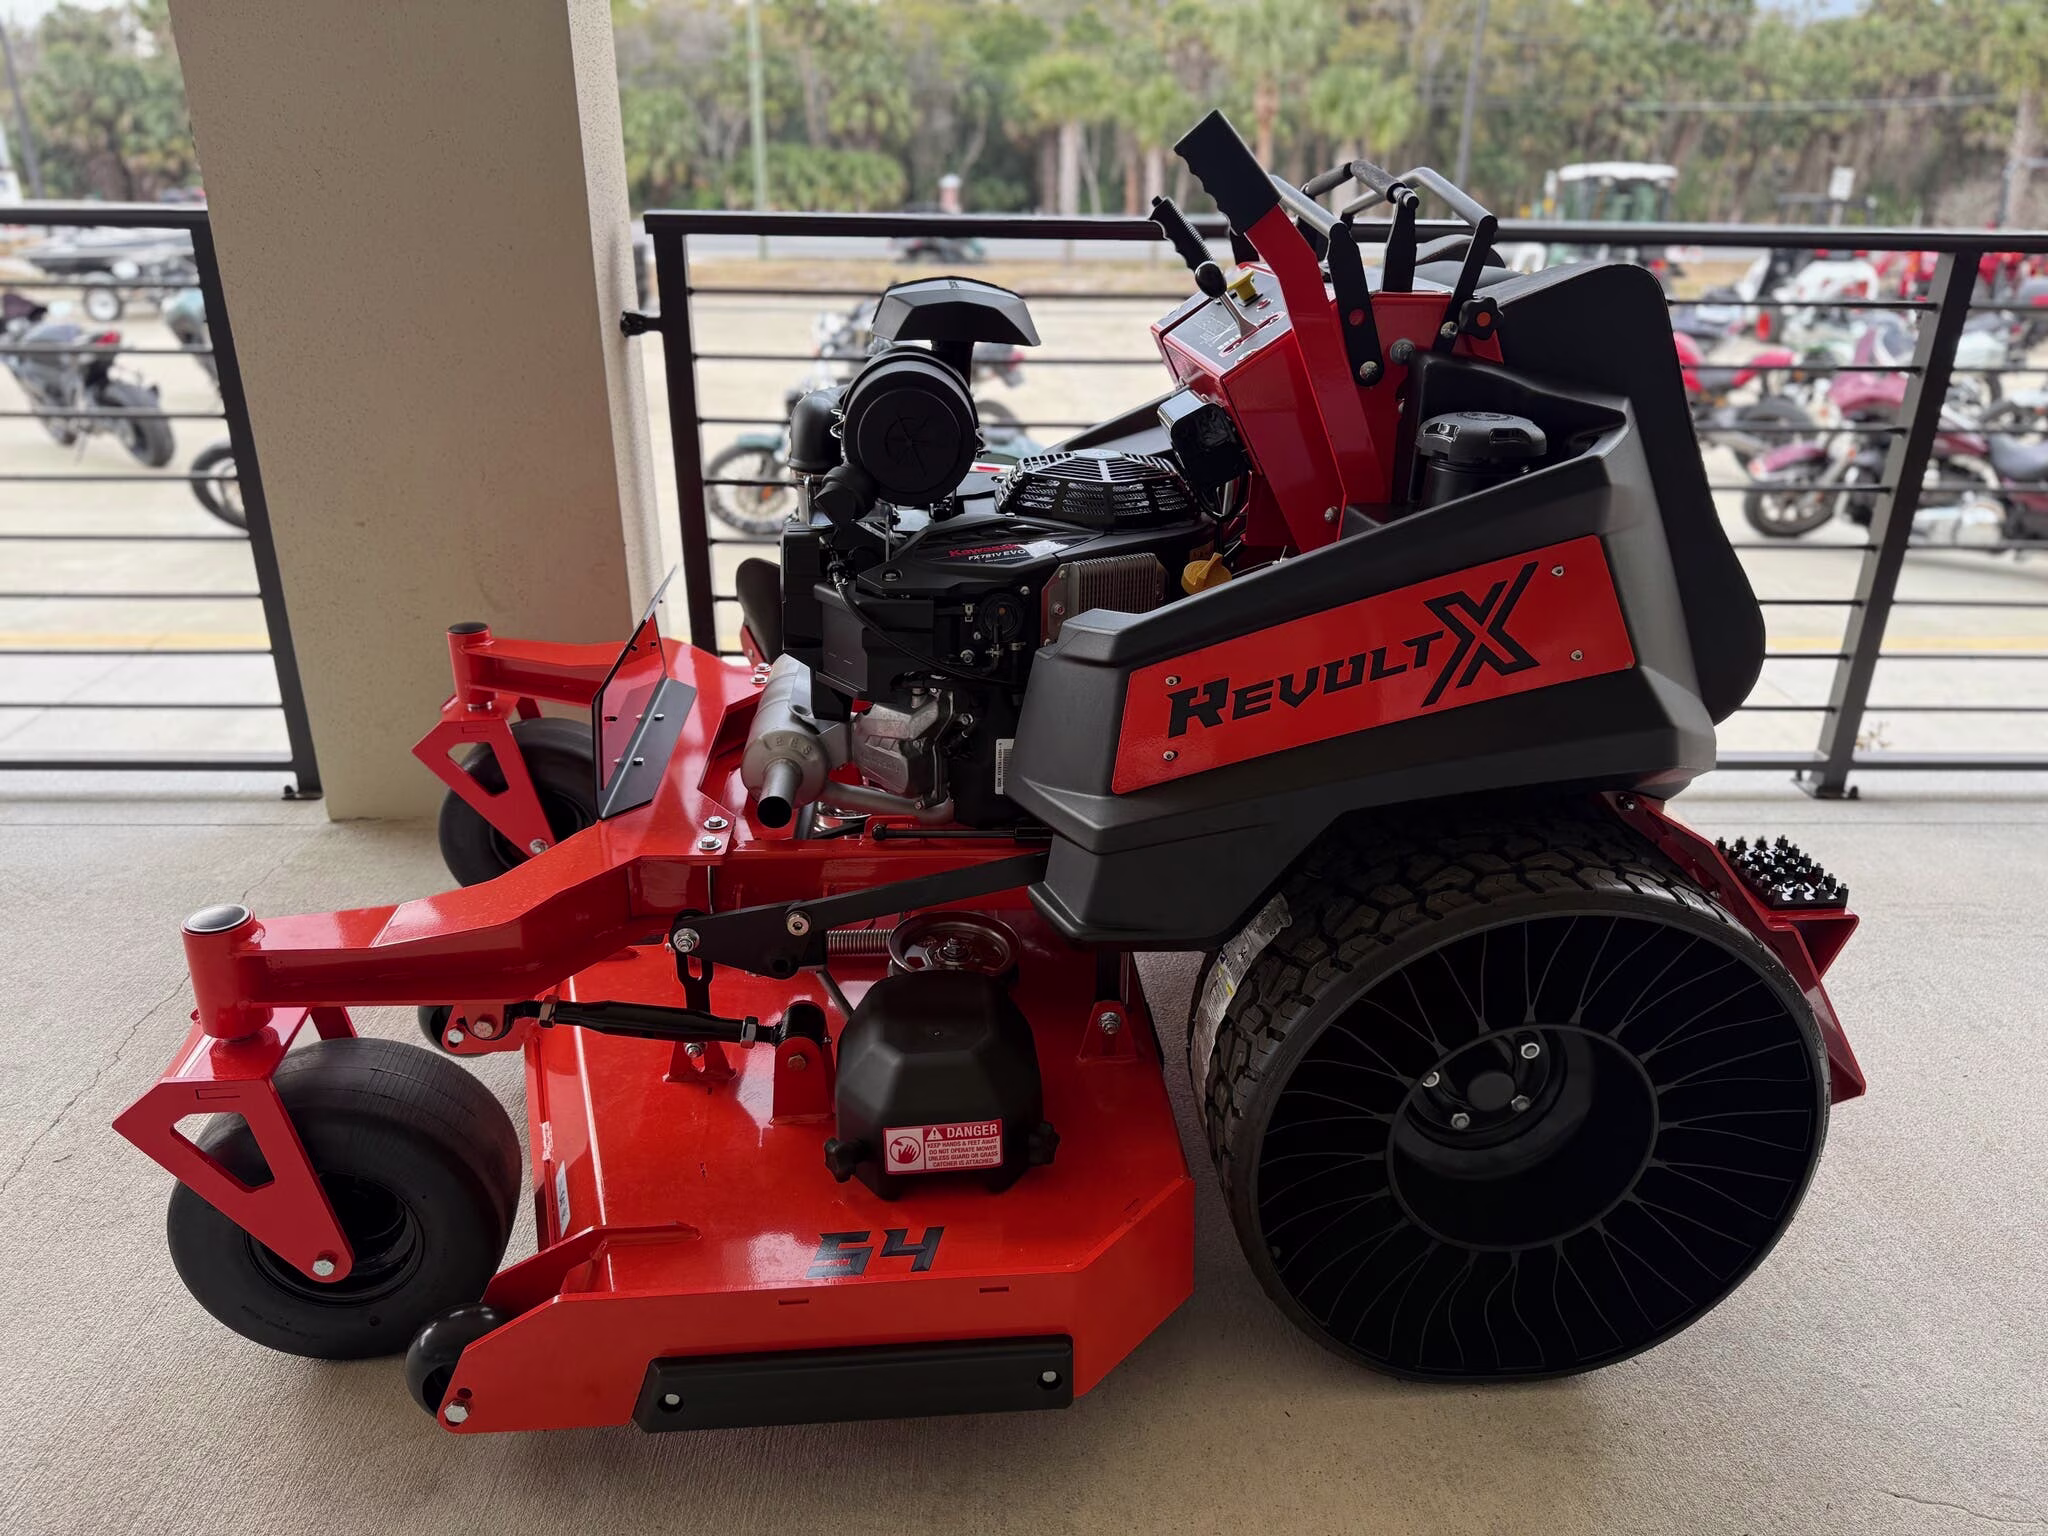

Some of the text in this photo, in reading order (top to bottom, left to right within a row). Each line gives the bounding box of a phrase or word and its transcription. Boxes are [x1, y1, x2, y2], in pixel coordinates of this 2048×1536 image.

[946, 1124, 998, 1138] DANGER
[927, 1141, 941, 1149] KEEP
[806, 1226, 945, 1279] 54
